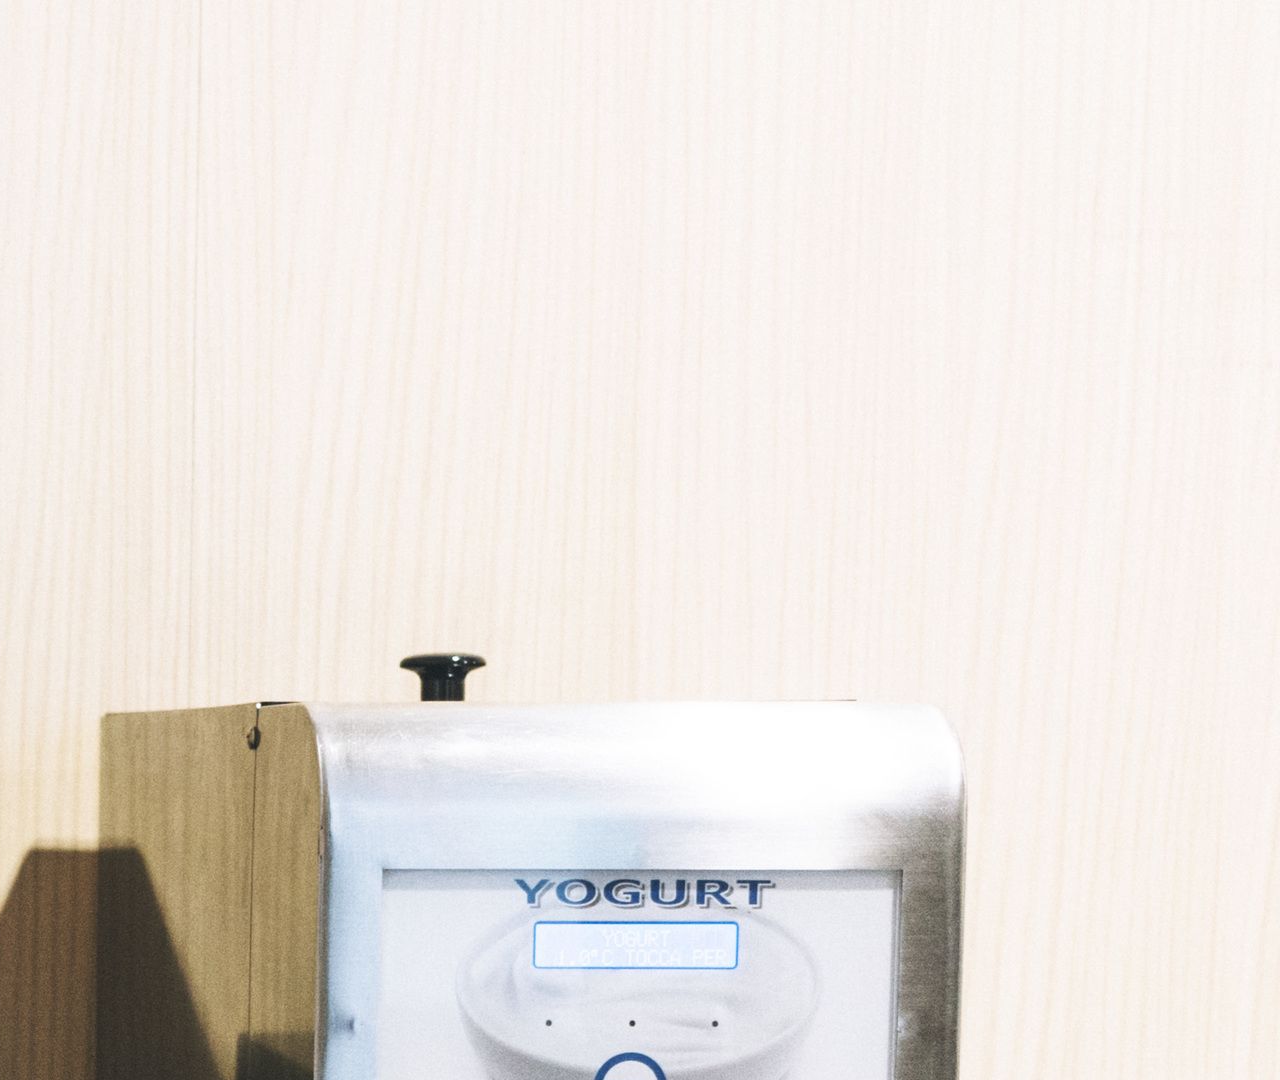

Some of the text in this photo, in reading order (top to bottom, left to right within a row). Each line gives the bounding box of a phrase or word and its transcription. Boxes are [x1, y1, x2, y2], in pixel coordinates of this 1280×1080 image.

[514, 878, 775, 909] YOGURT
[602, 929, 671, 948] YOGURT
[625, 948, 681, 966] TOCCA
